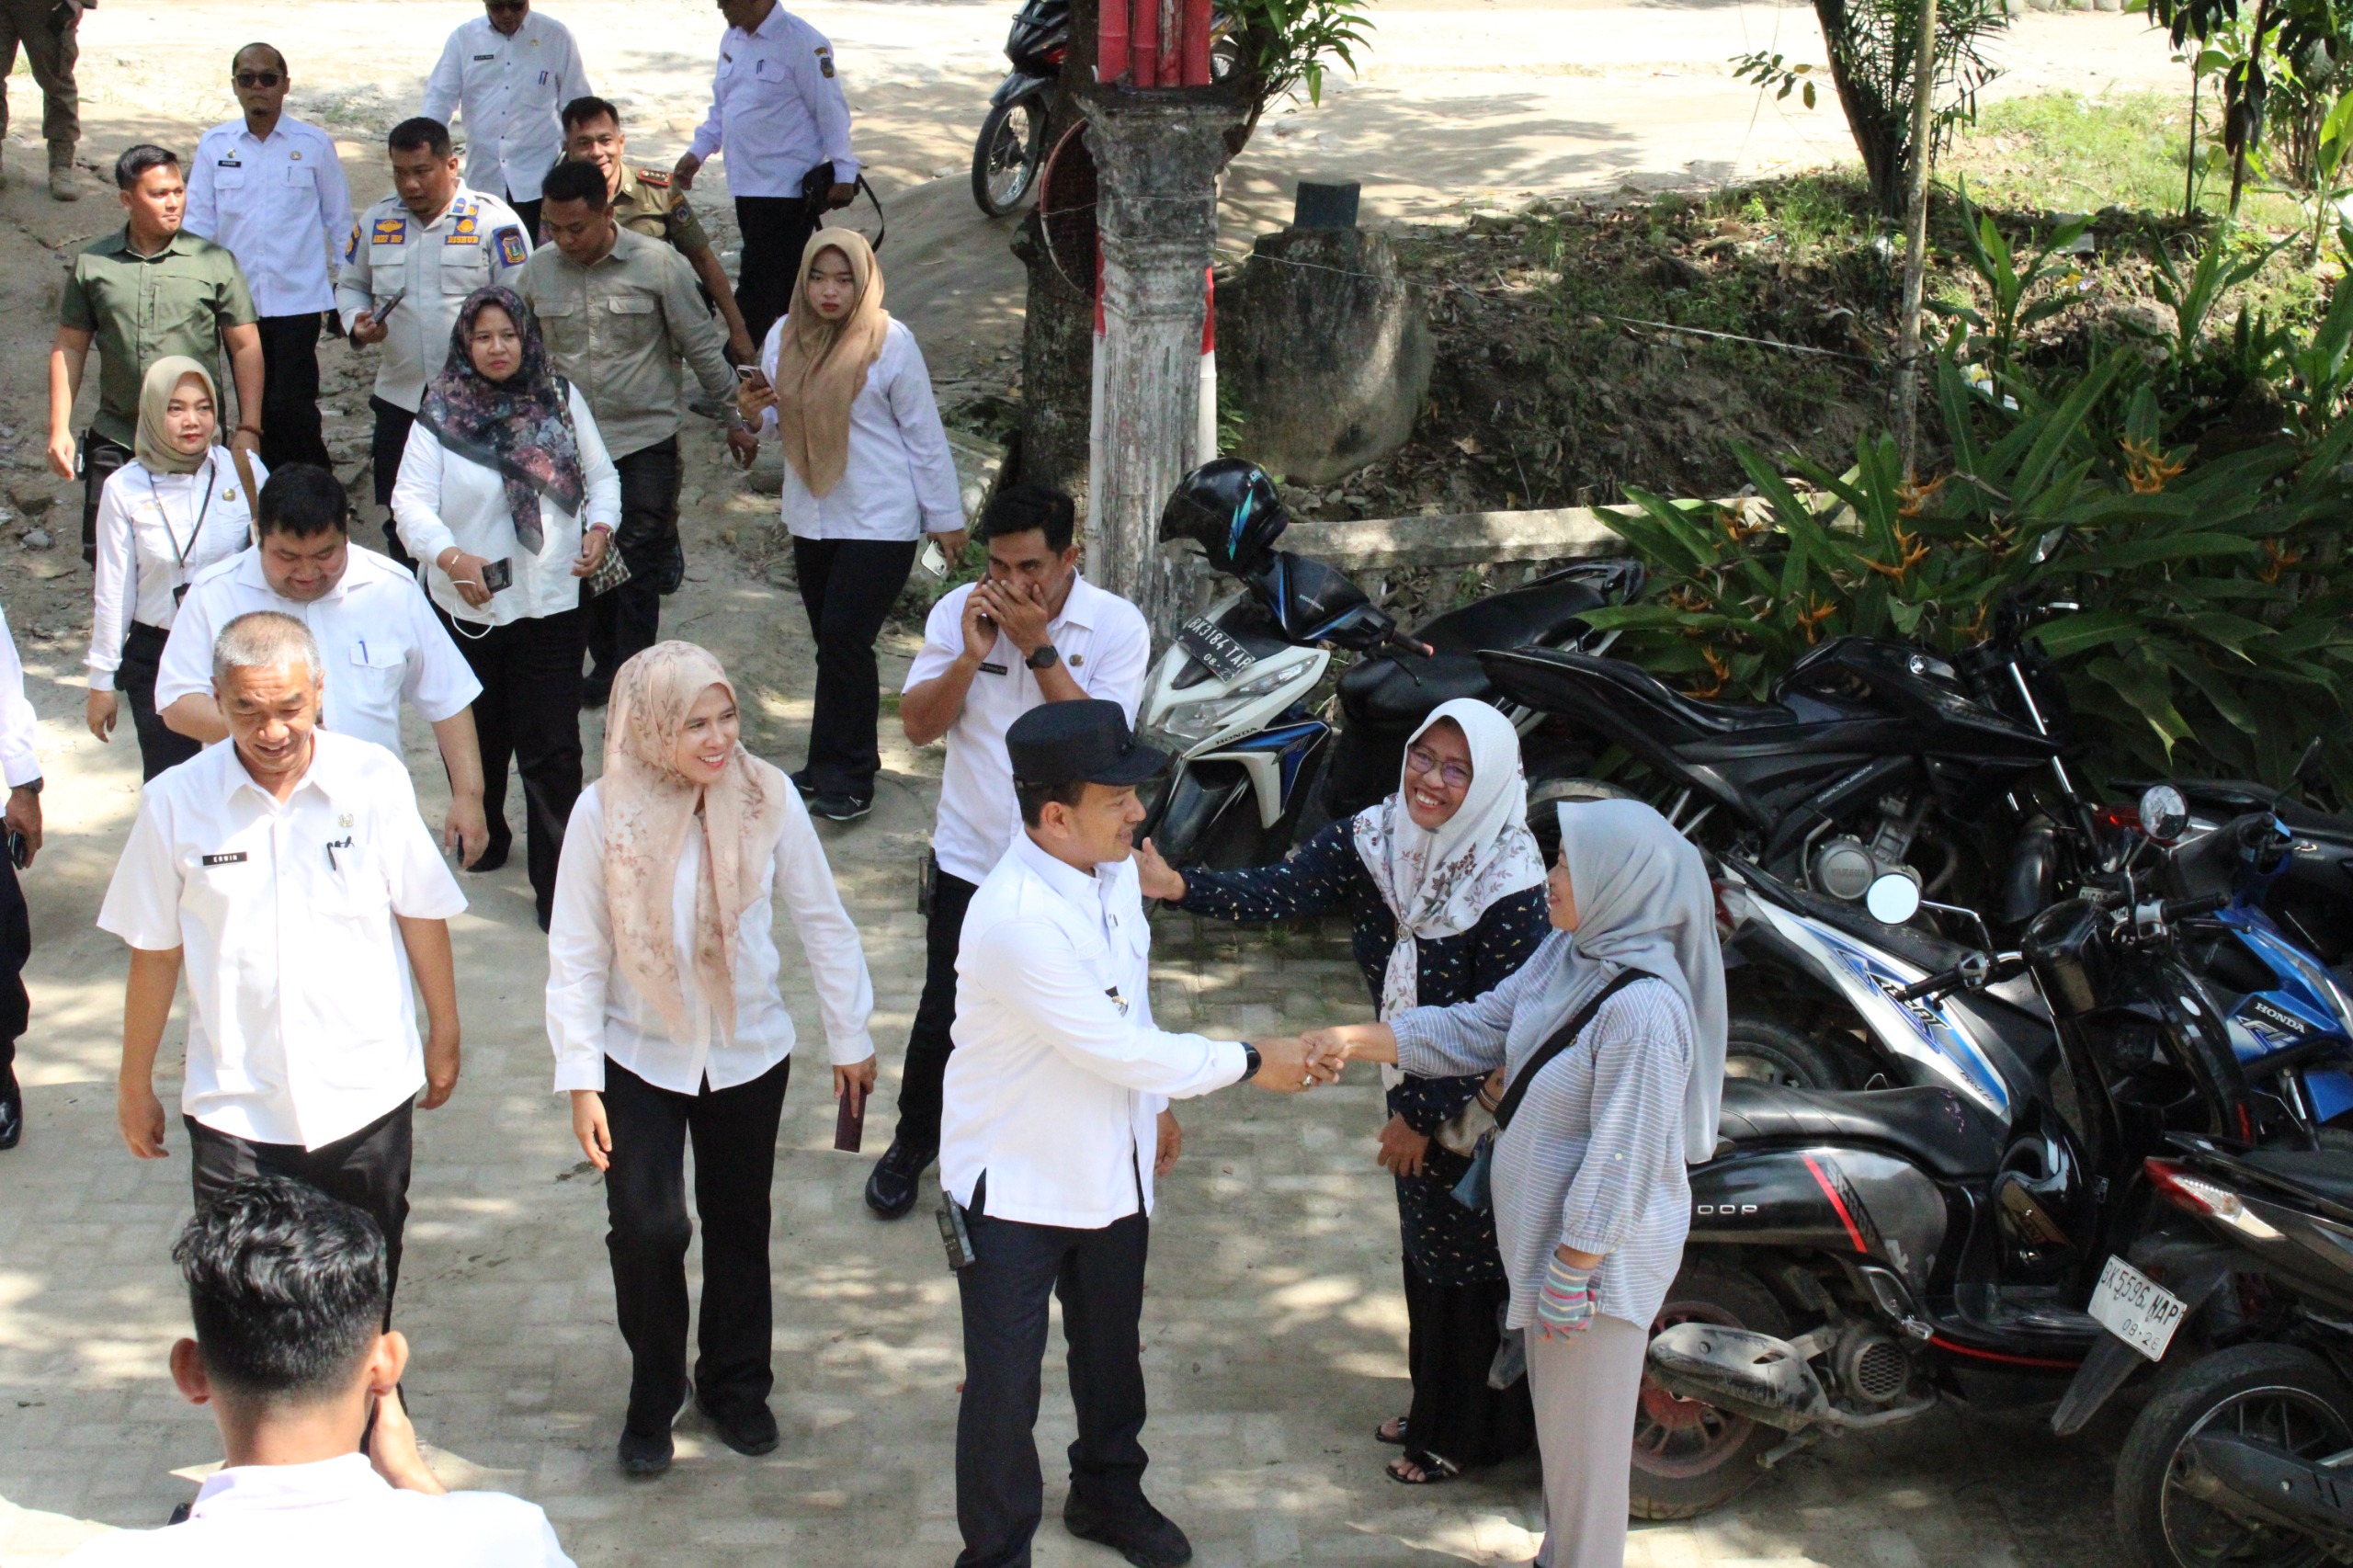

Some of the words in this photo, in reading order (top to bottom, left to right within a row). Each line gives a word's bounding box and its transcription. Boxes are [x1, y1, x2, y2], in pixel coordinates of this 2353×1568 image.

[447, 235, 479, 244] DISHUB
[1299, 594, 1324, 612] HONDA
[1215, 727, 1258, 745] HONDA
[1817, 765, 1873, 802] DELTABOX
[2255, 1002, 2305, 1034] HONDA
